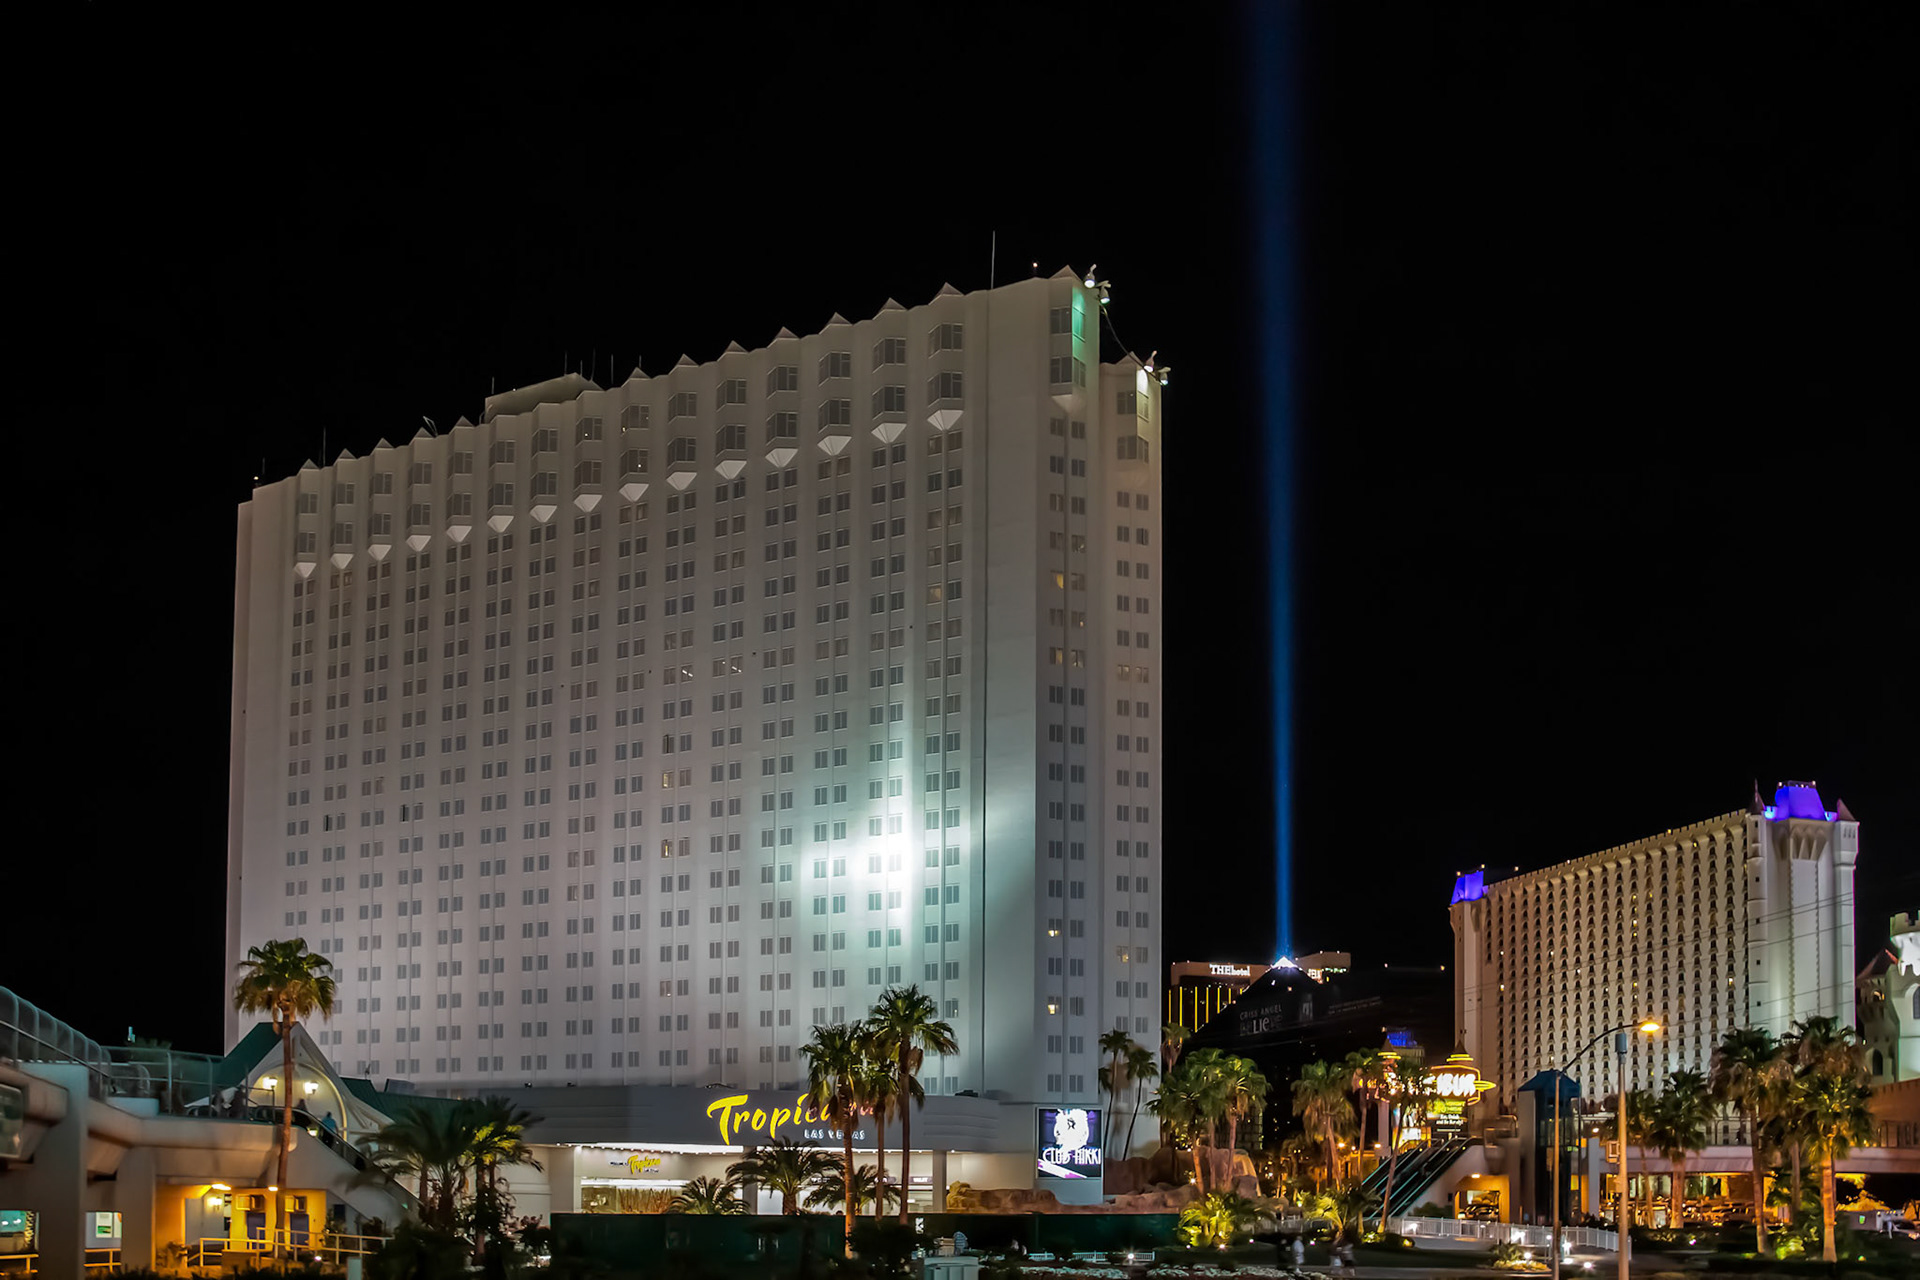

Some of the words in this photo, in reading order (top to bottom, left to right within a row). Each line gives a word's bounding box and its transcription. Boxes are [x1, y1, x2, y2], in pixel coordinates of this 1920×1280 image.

[1209, 963, 1251, 977] THEhotel
[1260, 1003, 1282, 1015] ANGEL
[804, 1128, 824, 1139] LAS
[828, 1128, 866, 1140] VEAS
